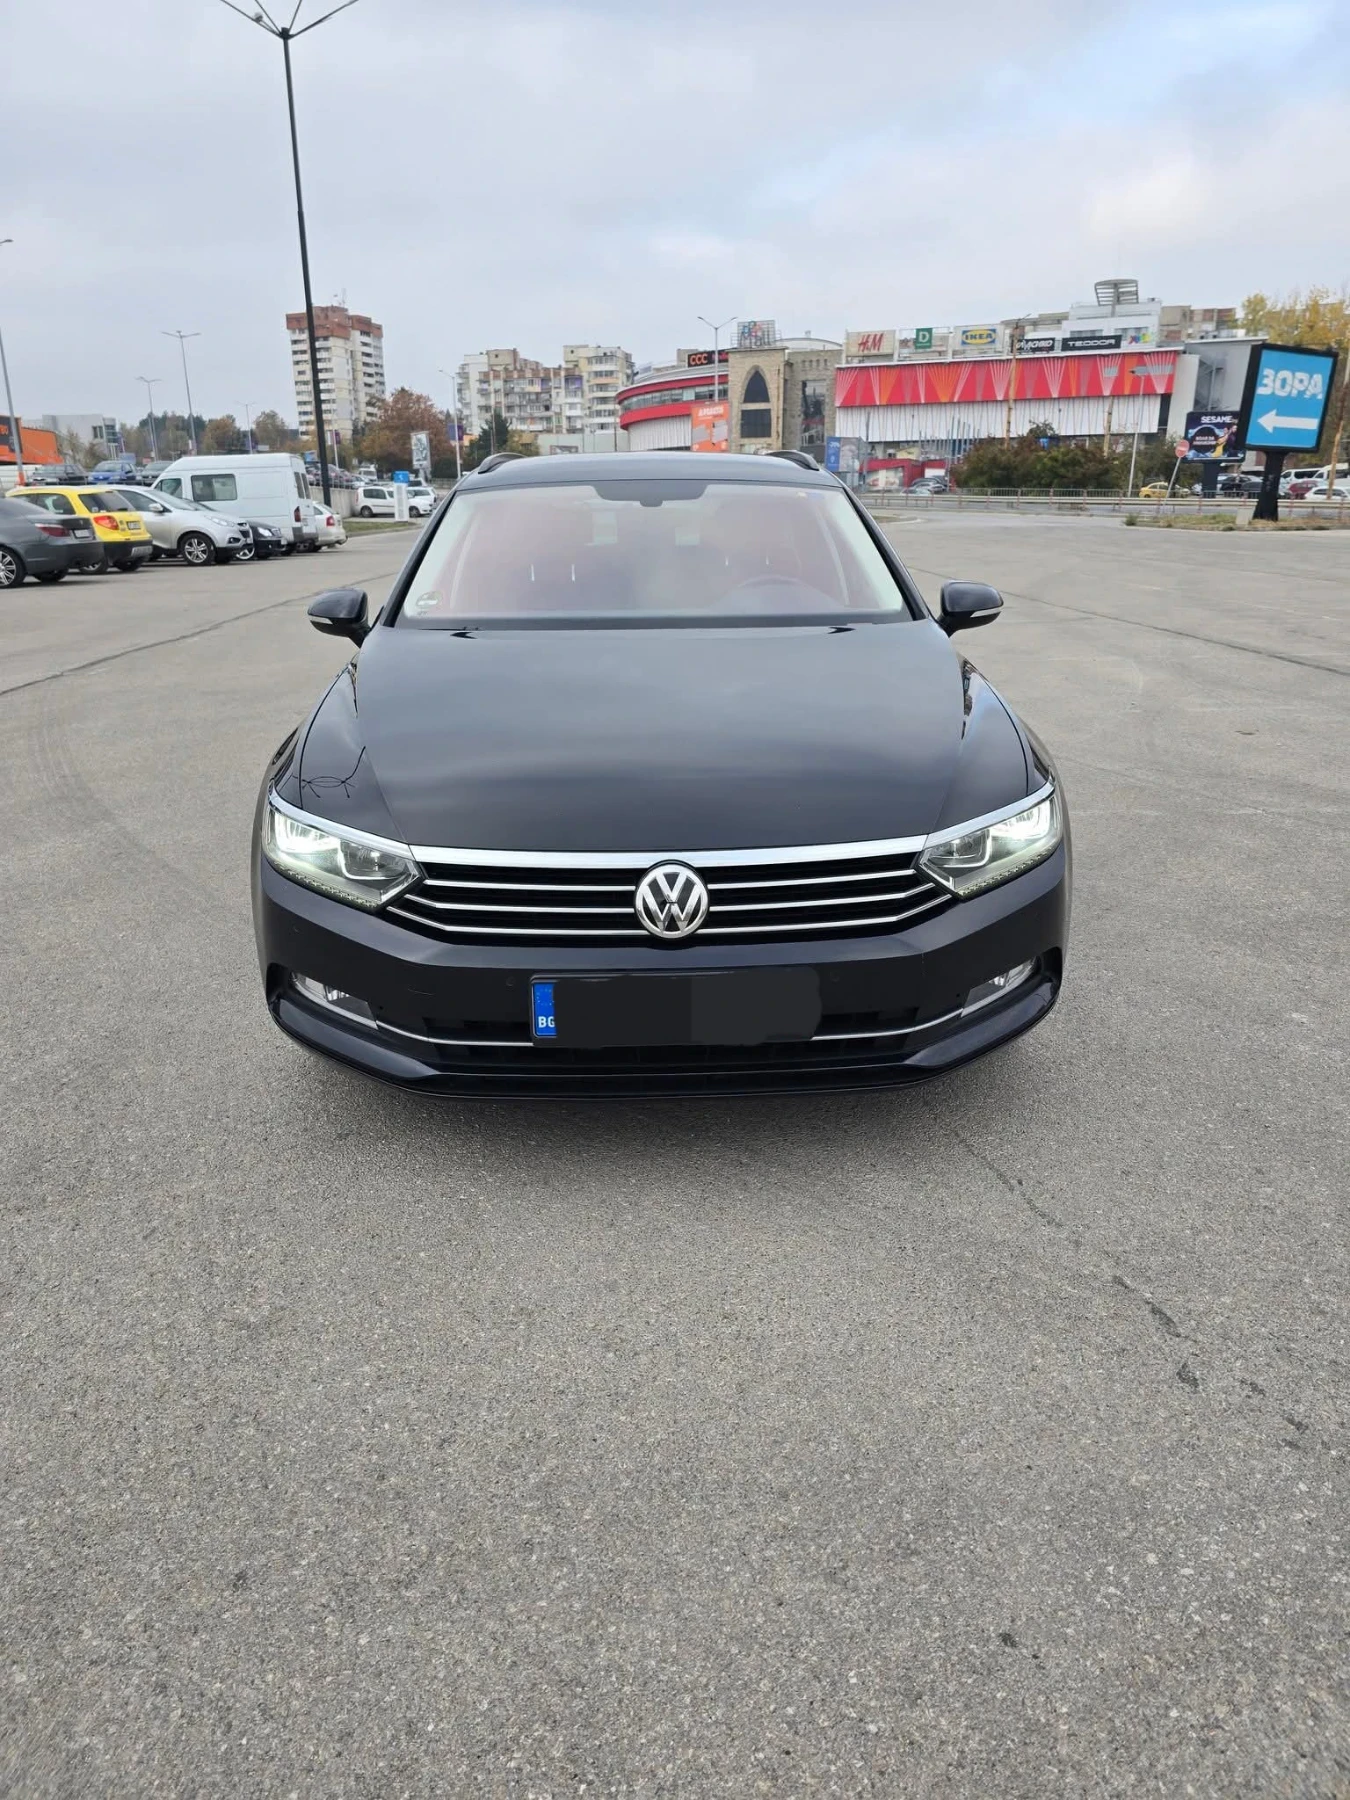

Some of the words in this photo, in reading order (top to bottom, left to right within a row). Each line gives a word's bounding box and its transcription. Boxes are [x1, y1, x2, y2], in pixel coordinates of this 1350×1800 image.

[857, 333, 885, 352] H&M
[965, 333, 993, 341] IKEA
[1067, 338, 1116, 347] TEODOR
[690, 354, 708, 365] CCC
[1257, 368, 1323, 399] ЗОРА
[1200, 415, 1233, 424] SESAME
[538, 1016, 555, 1028] BG
